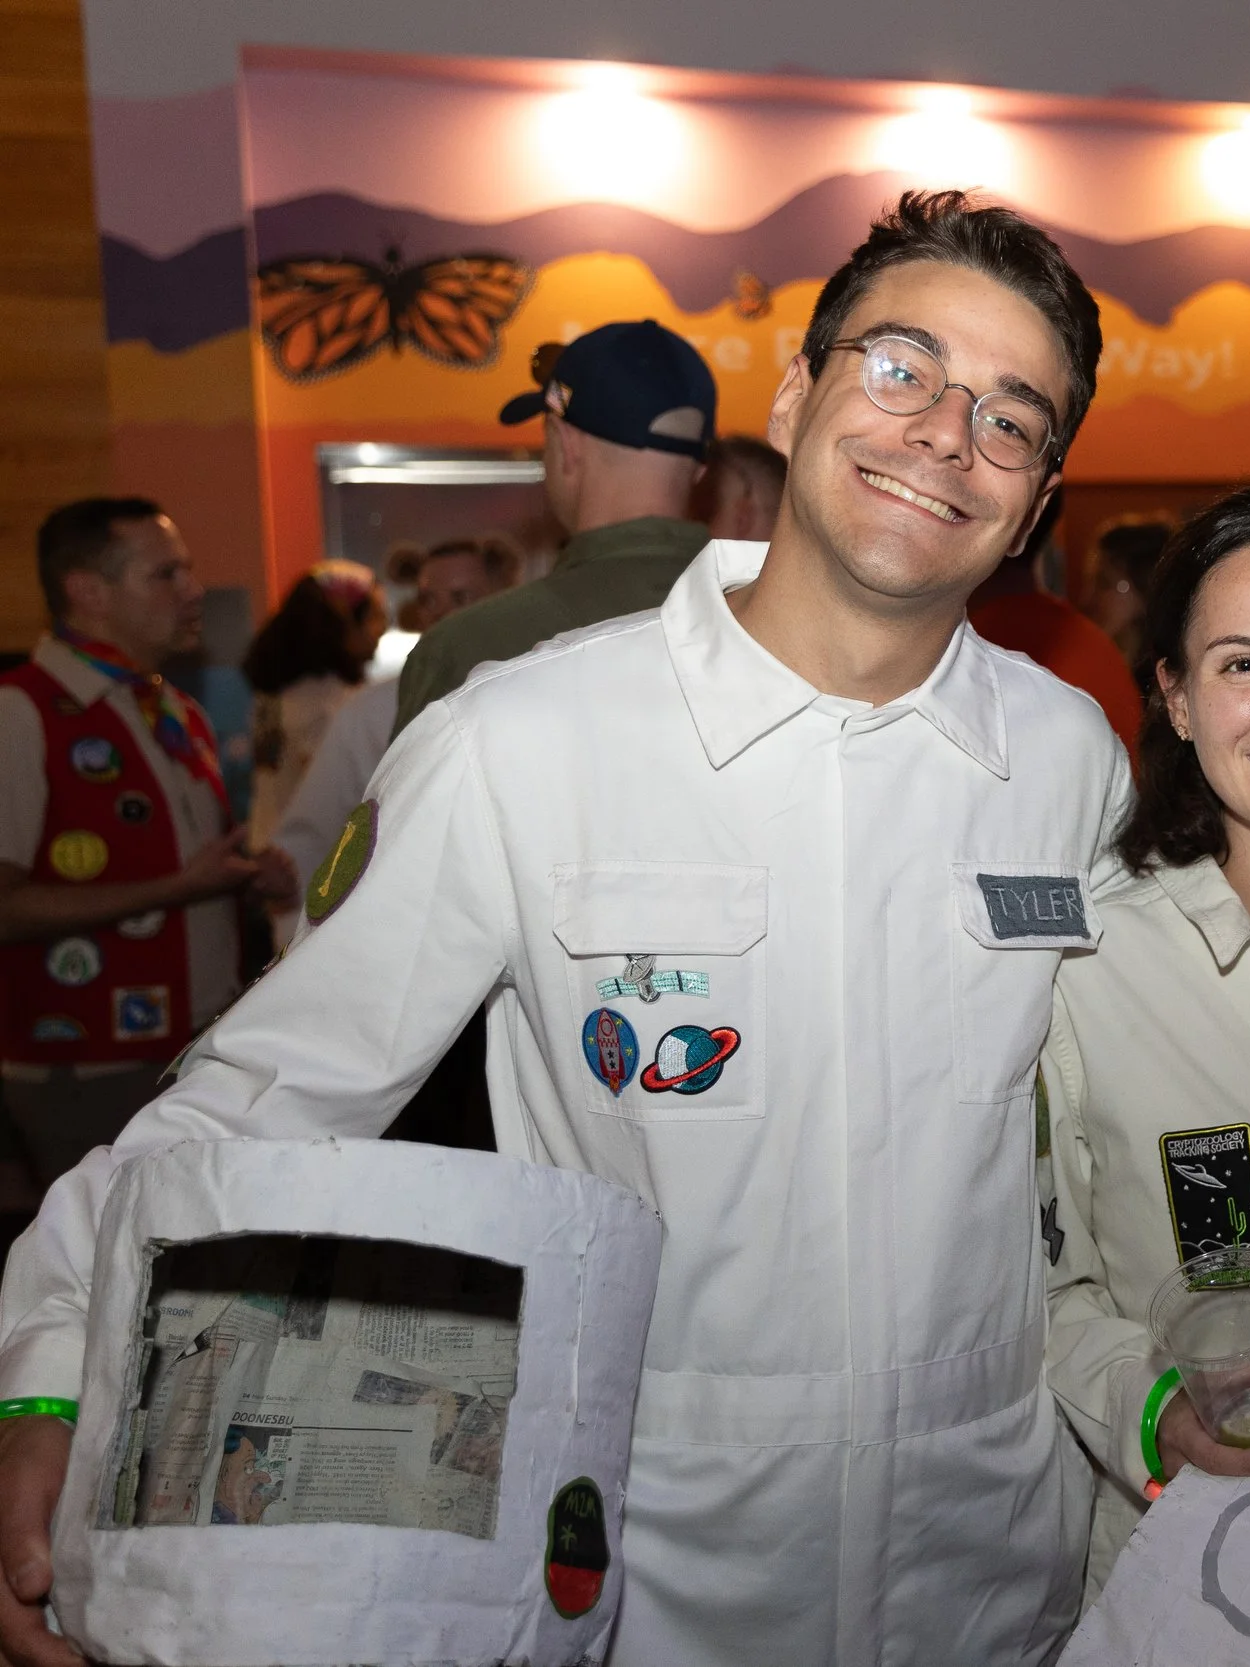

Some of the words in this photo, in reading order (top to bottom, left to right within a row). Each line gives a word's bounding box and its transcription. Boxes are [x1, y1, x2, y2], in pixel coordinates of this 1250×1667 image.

[990, 886, 1085, 921] TYLER
[1167, 1130, 1245, 1150] CRYPTOZOOLOGY
[1167, 1144, 1210, 1158] TRACKING
[1211, 1138, 1245, 1154] SOCIETY
